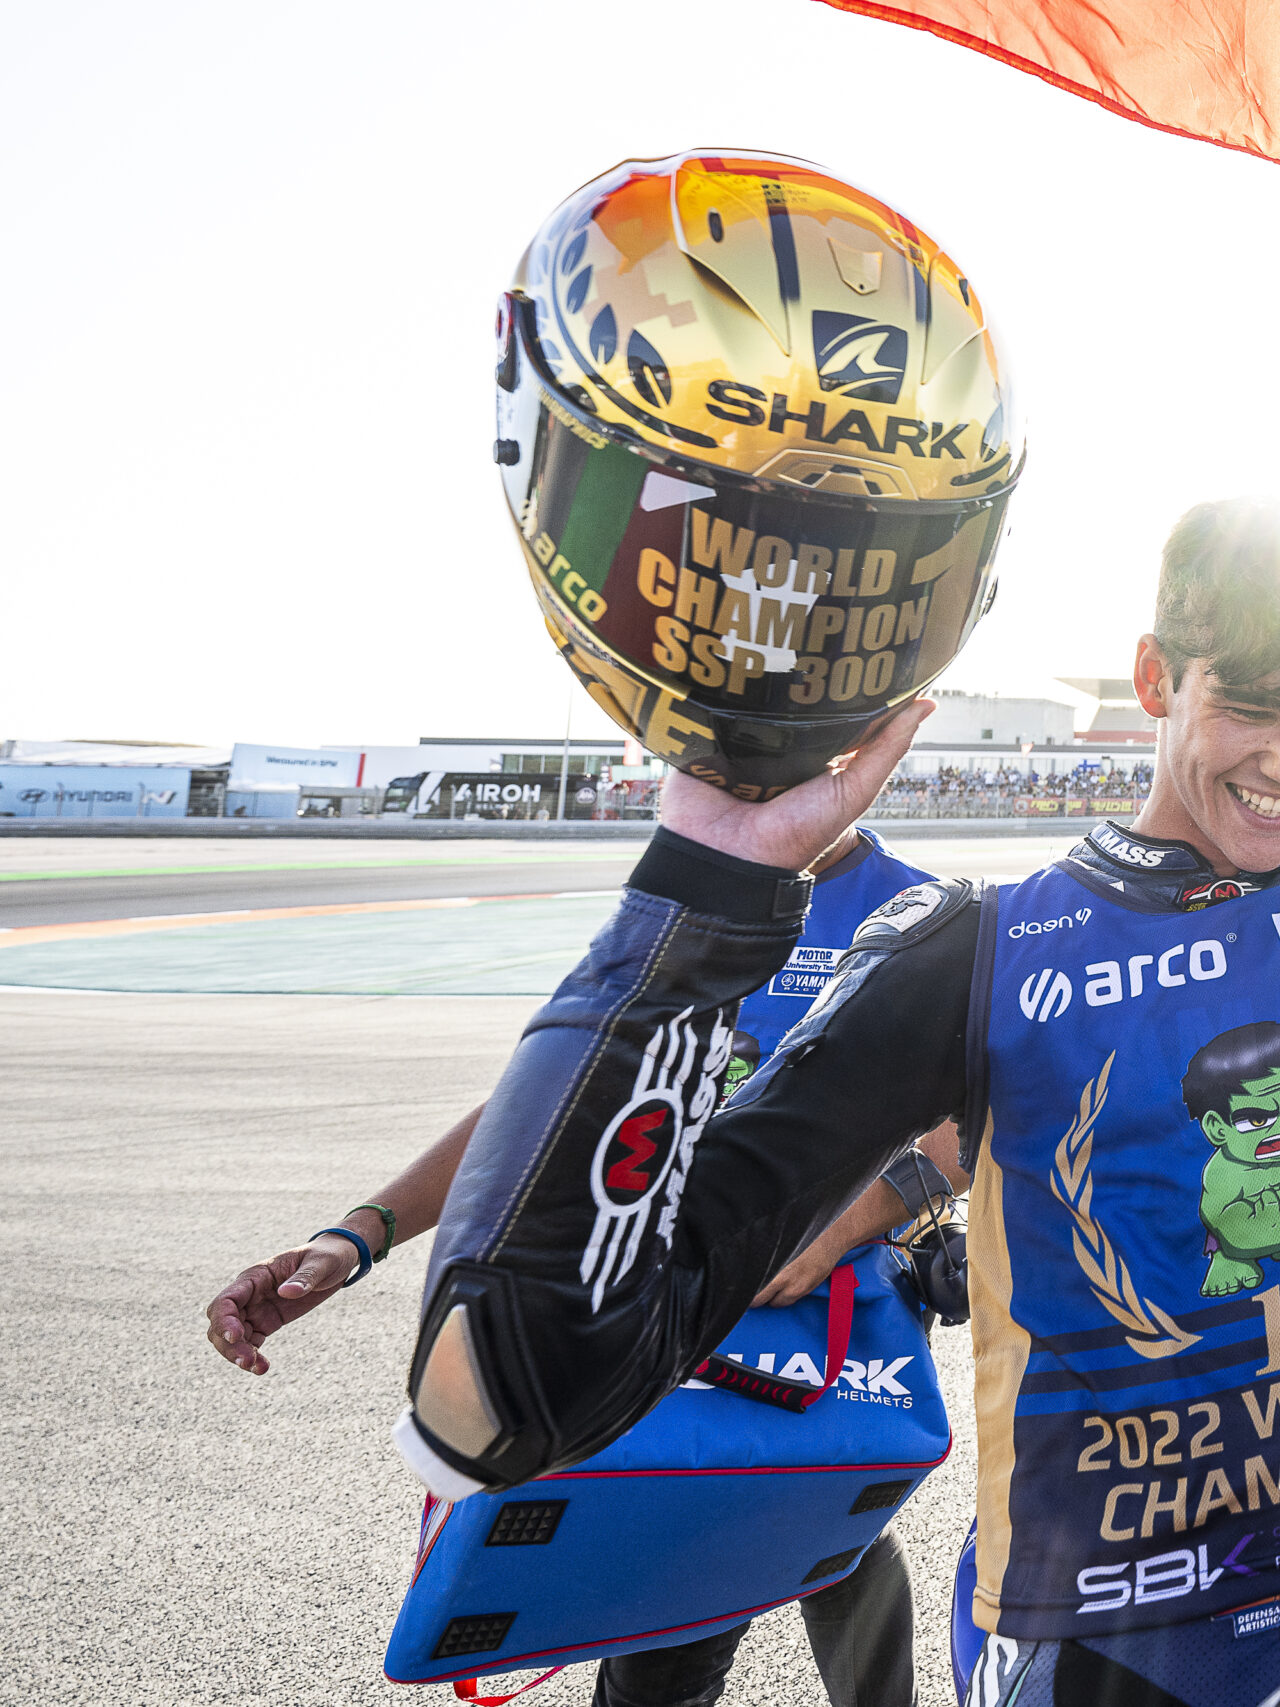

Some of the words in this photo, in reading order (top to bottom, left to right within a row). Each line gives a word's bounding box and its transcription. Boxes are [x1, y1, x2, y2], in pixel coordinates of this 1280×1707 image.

[707, 380, 968, 460] SHARK
[532, 531, 608, 622] arco
[692, 508, 897, 597] WORLD
[637, 548, 930, 654] CHAMPION
[653, 615, 765, 695] SSP
[789, 651, 896, 704] 300
[53, 790, 133, 802] HYUNDAI
[1096, 832, 1175, 867] MASS
[786, 962, 821, 971] University
[797, 949, 833, 960] MOTOR
[1084, 939, 1228, 1007] arco
[837, 1389, 913, 1409] HELMETS
[1077, 1401, 1224, 1472] 2022
[1076, 1532, 1260, 1614] SBK
[1238, 1605, 1280, 1625] DEFENSA
